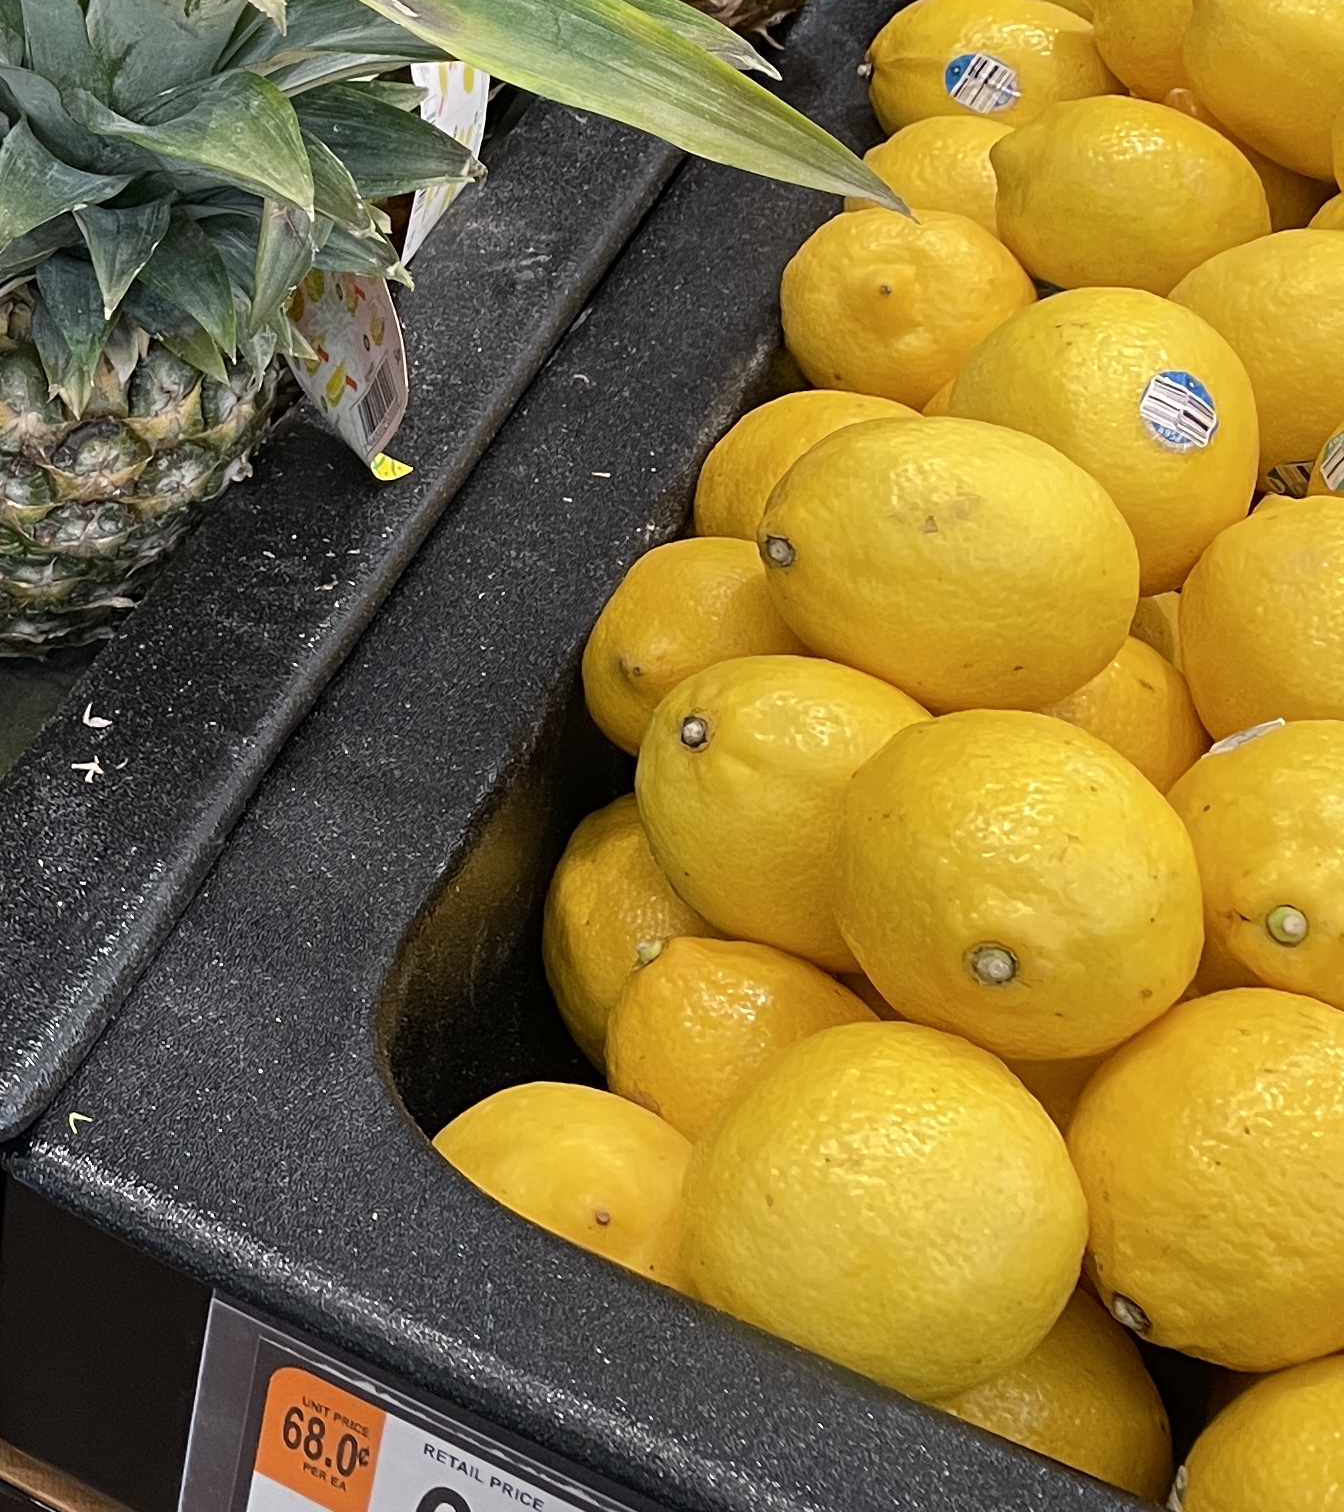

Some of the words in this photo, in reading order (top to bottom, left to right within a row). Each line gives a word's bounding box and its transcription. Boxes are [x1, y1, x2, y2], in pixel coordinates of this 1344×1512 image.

[302, 1395, 330, 1418] UNIT
[333, 1412, 370, 1438] PRICE
[302, 1462, 327, 1481] PER
[330, 1475, 347, 1492] EA
[423, 1442, 485, 1484] RETAIL
[489, 1475, 545, 1512] PRICE
